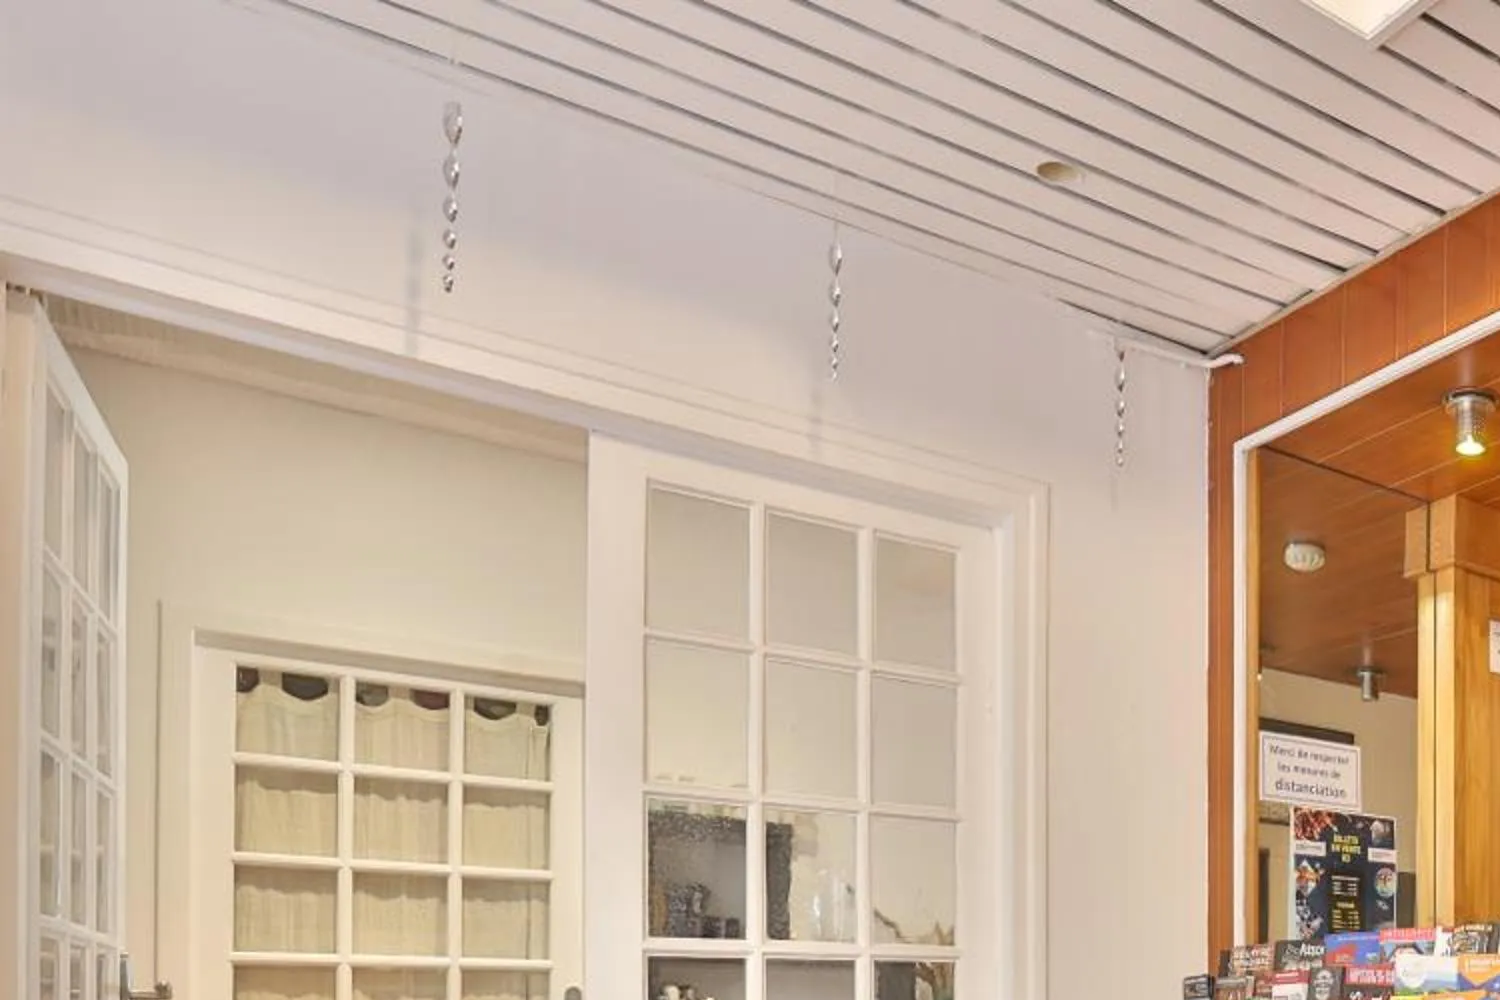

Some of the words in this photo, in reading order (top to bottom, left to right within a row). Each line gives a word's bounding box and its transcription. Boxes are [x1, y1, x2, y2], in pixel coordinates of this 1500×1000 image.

[1269, 744, 1295, 757] Merci
[1298, 749, 1308, 759] de
[1310, 752, 1349, 765] respecter
[1277, 762, 1291, 773] les
[1293, 764, 1329, 778] mesures
[1275, 778, 1347, 798] distanciation
